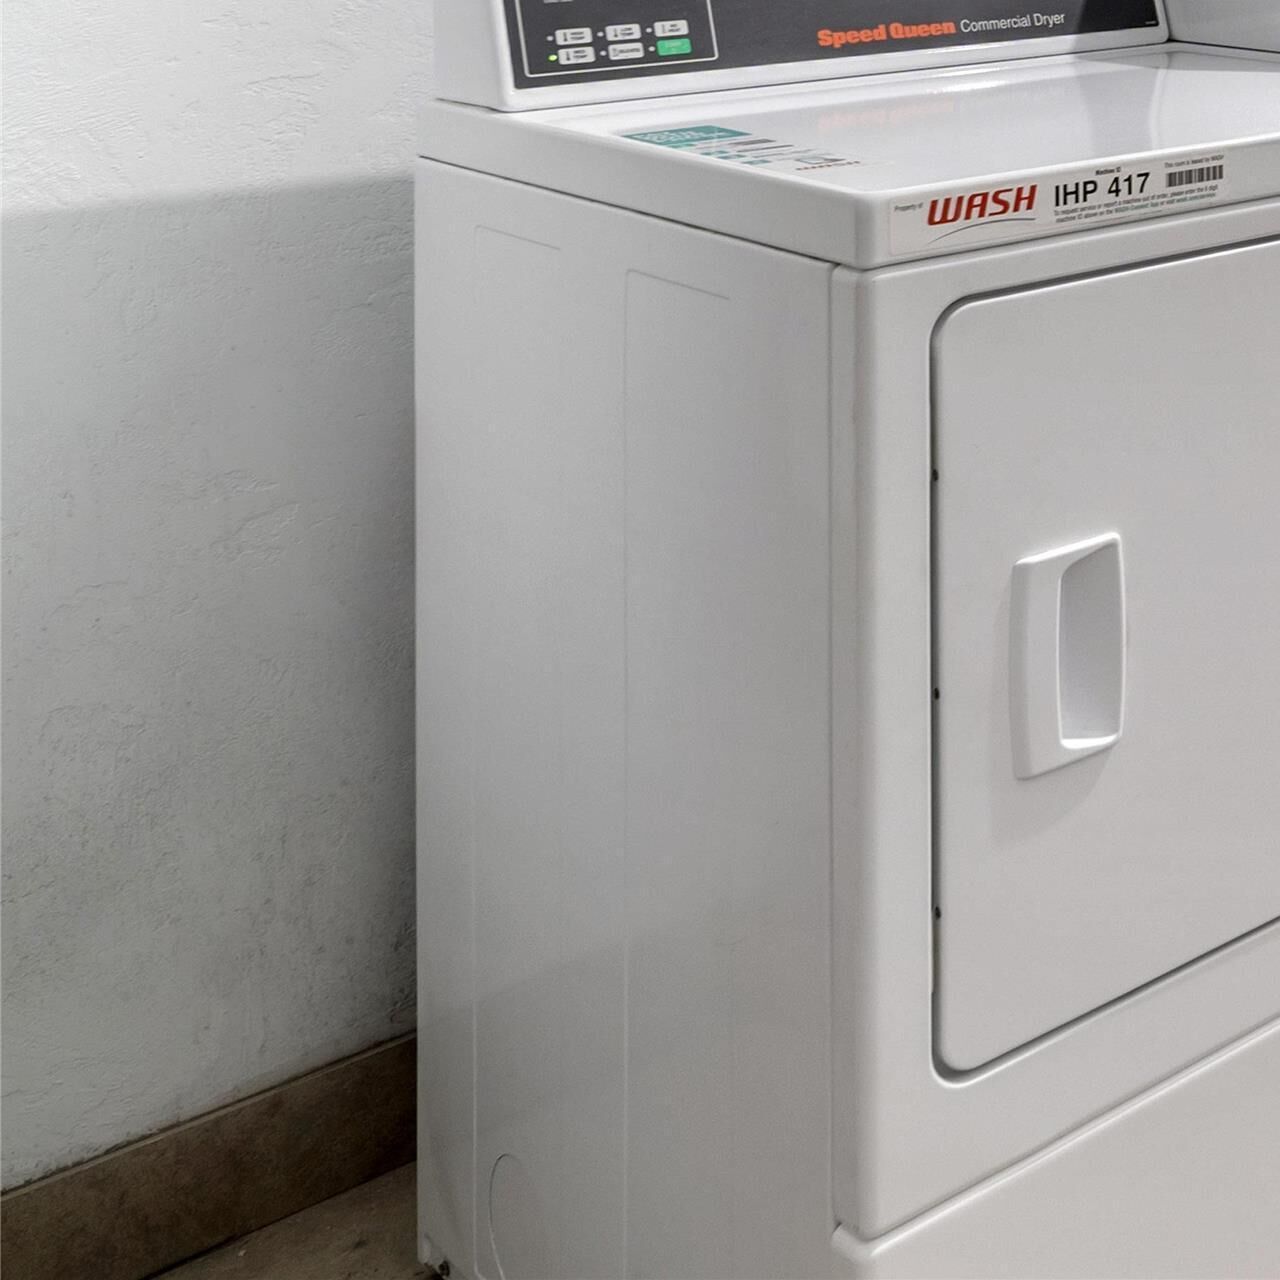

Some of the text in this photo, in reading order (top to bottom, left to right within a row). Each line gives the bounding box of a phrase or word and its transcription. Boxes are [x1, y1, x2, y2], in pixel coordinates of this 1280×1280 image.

[817, 12, 1066, 48] Speed Queen Commercial Dryer
[926, 184, 1037, 226] WASH
[1054, 171, 1151, 208] IHP 417
